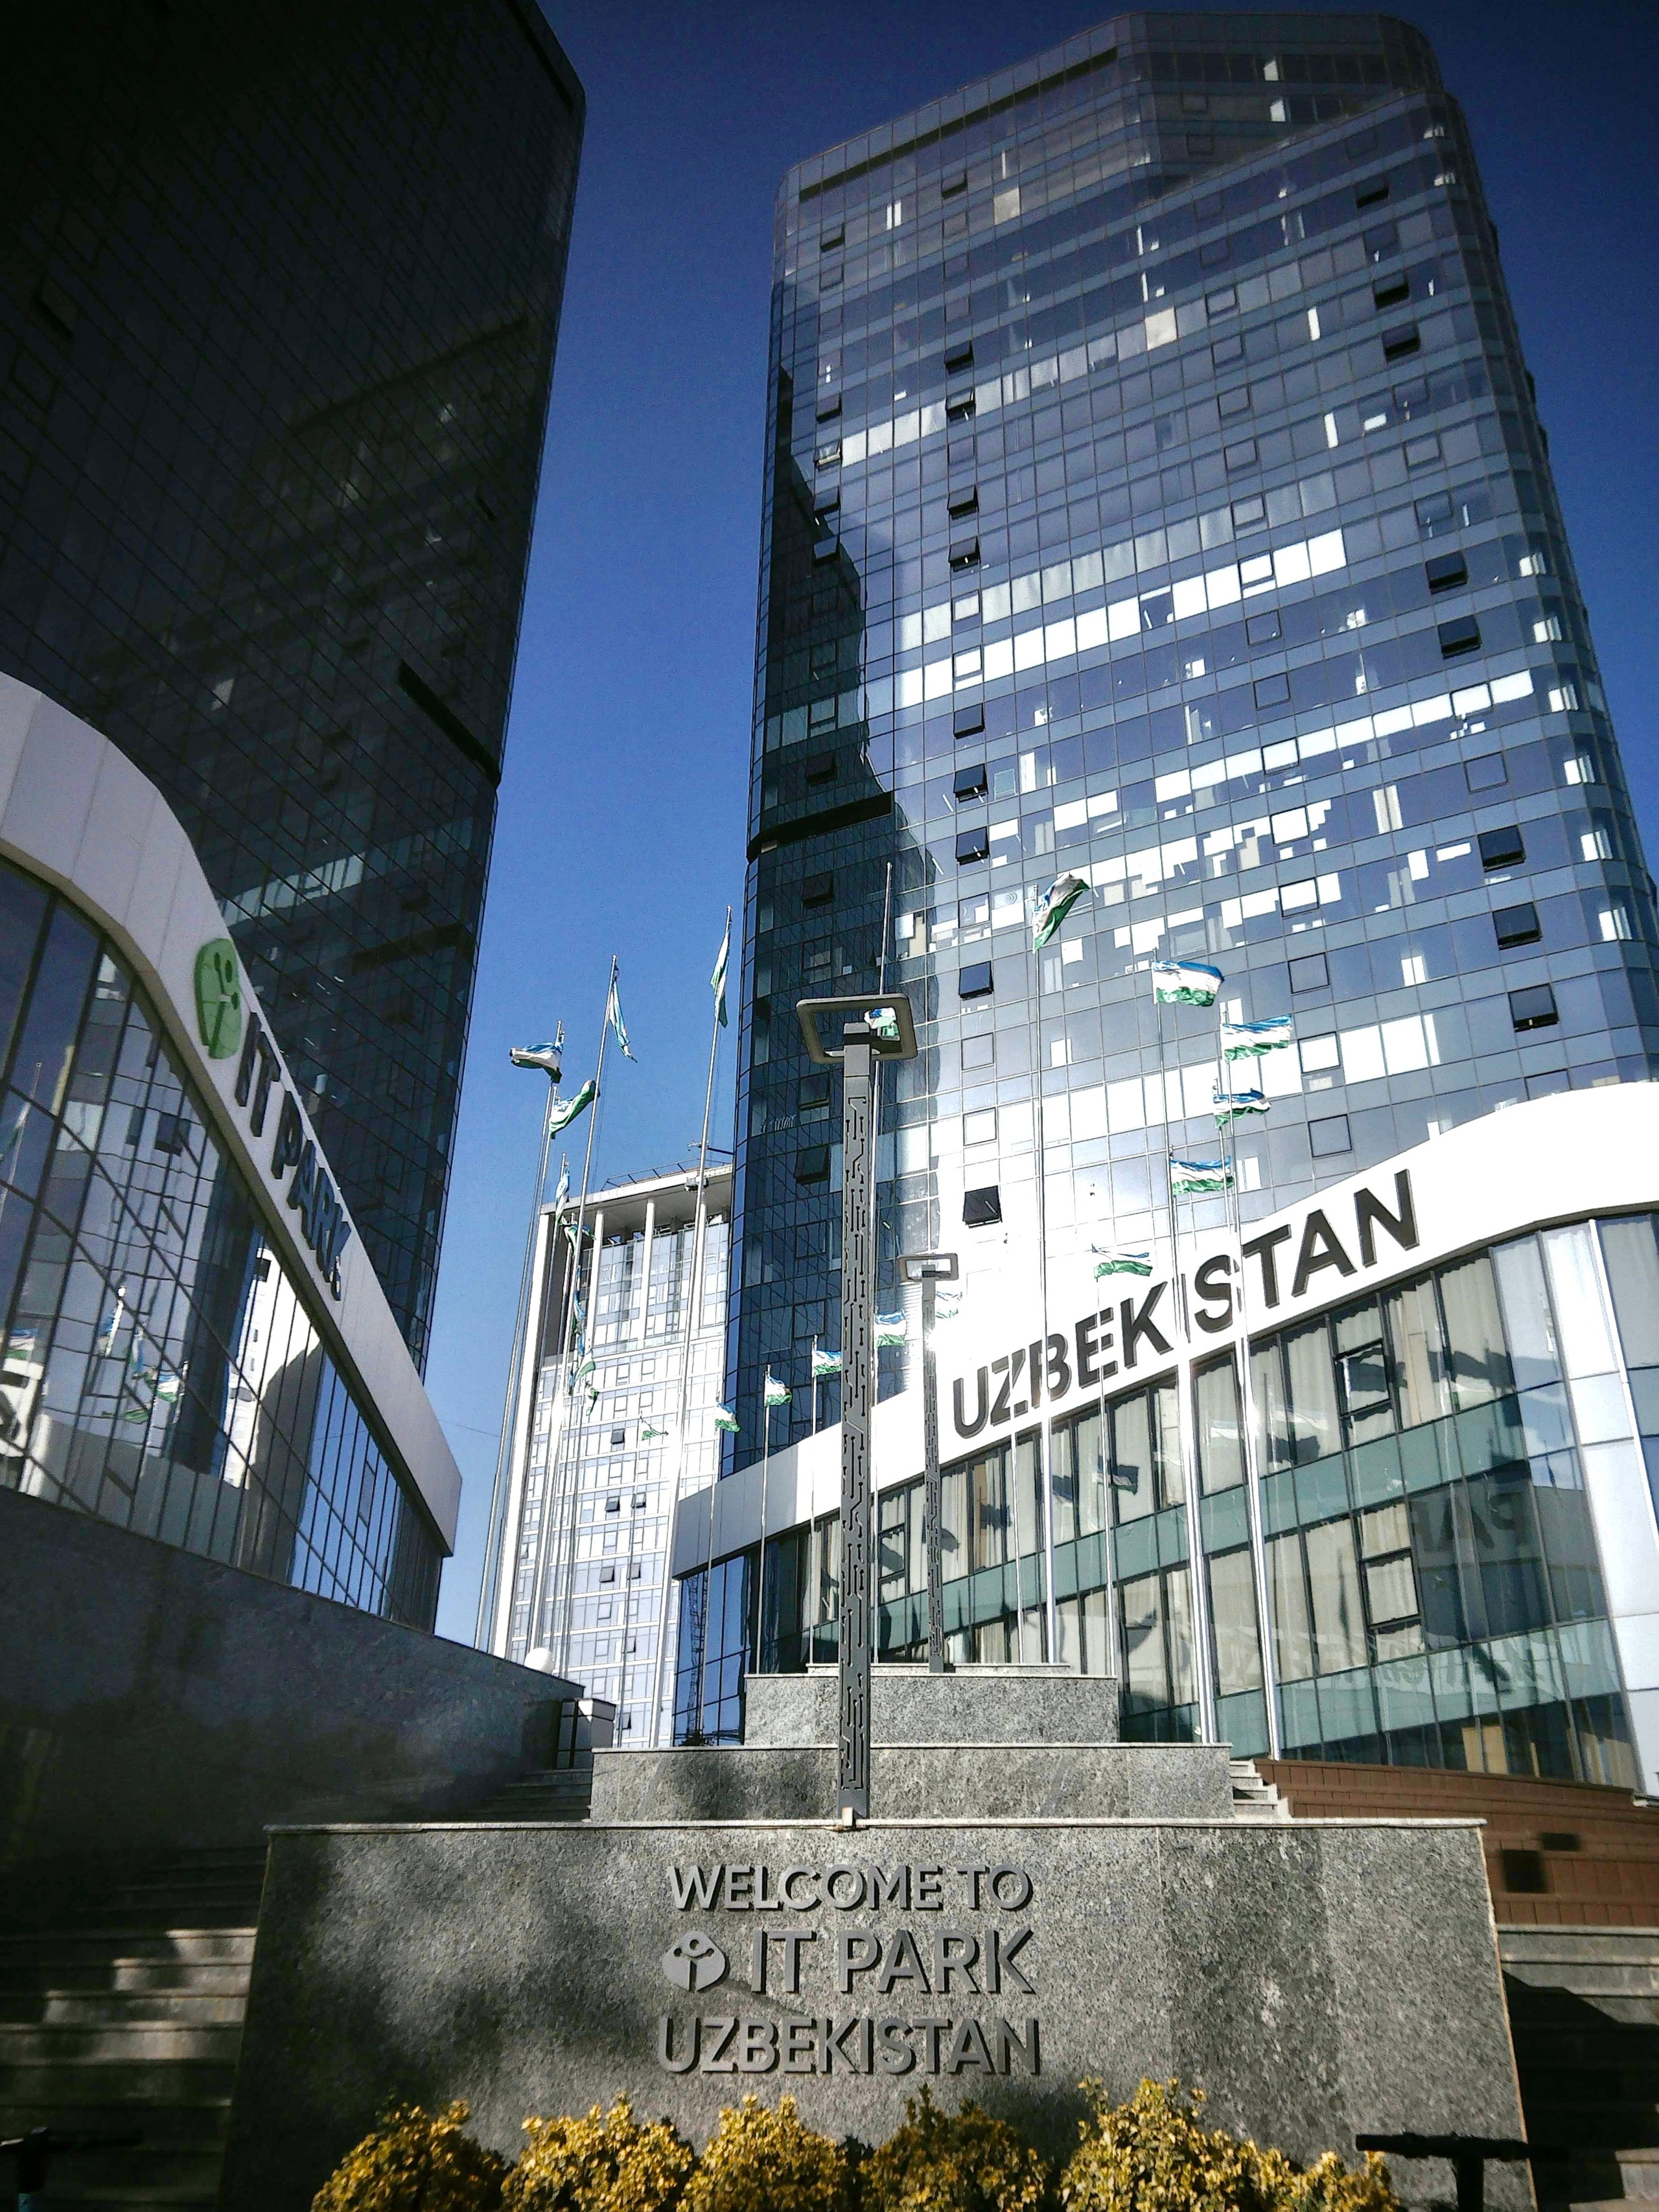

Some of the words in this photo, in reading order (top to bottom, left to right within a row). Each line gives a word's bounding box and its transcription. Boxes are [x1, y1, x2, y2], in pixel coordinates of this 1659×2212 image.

[235, 1011, 281, 1138] IT
[666, 1864, 944, 1911] WELCOME
[957, 1864, 1033, 1911] TO
[751, 1929, 817, 1993] IT
[840, 1929, 1036, 1994] PARK
[657, 2018, 1039, 2074] UZBEKISTAN
